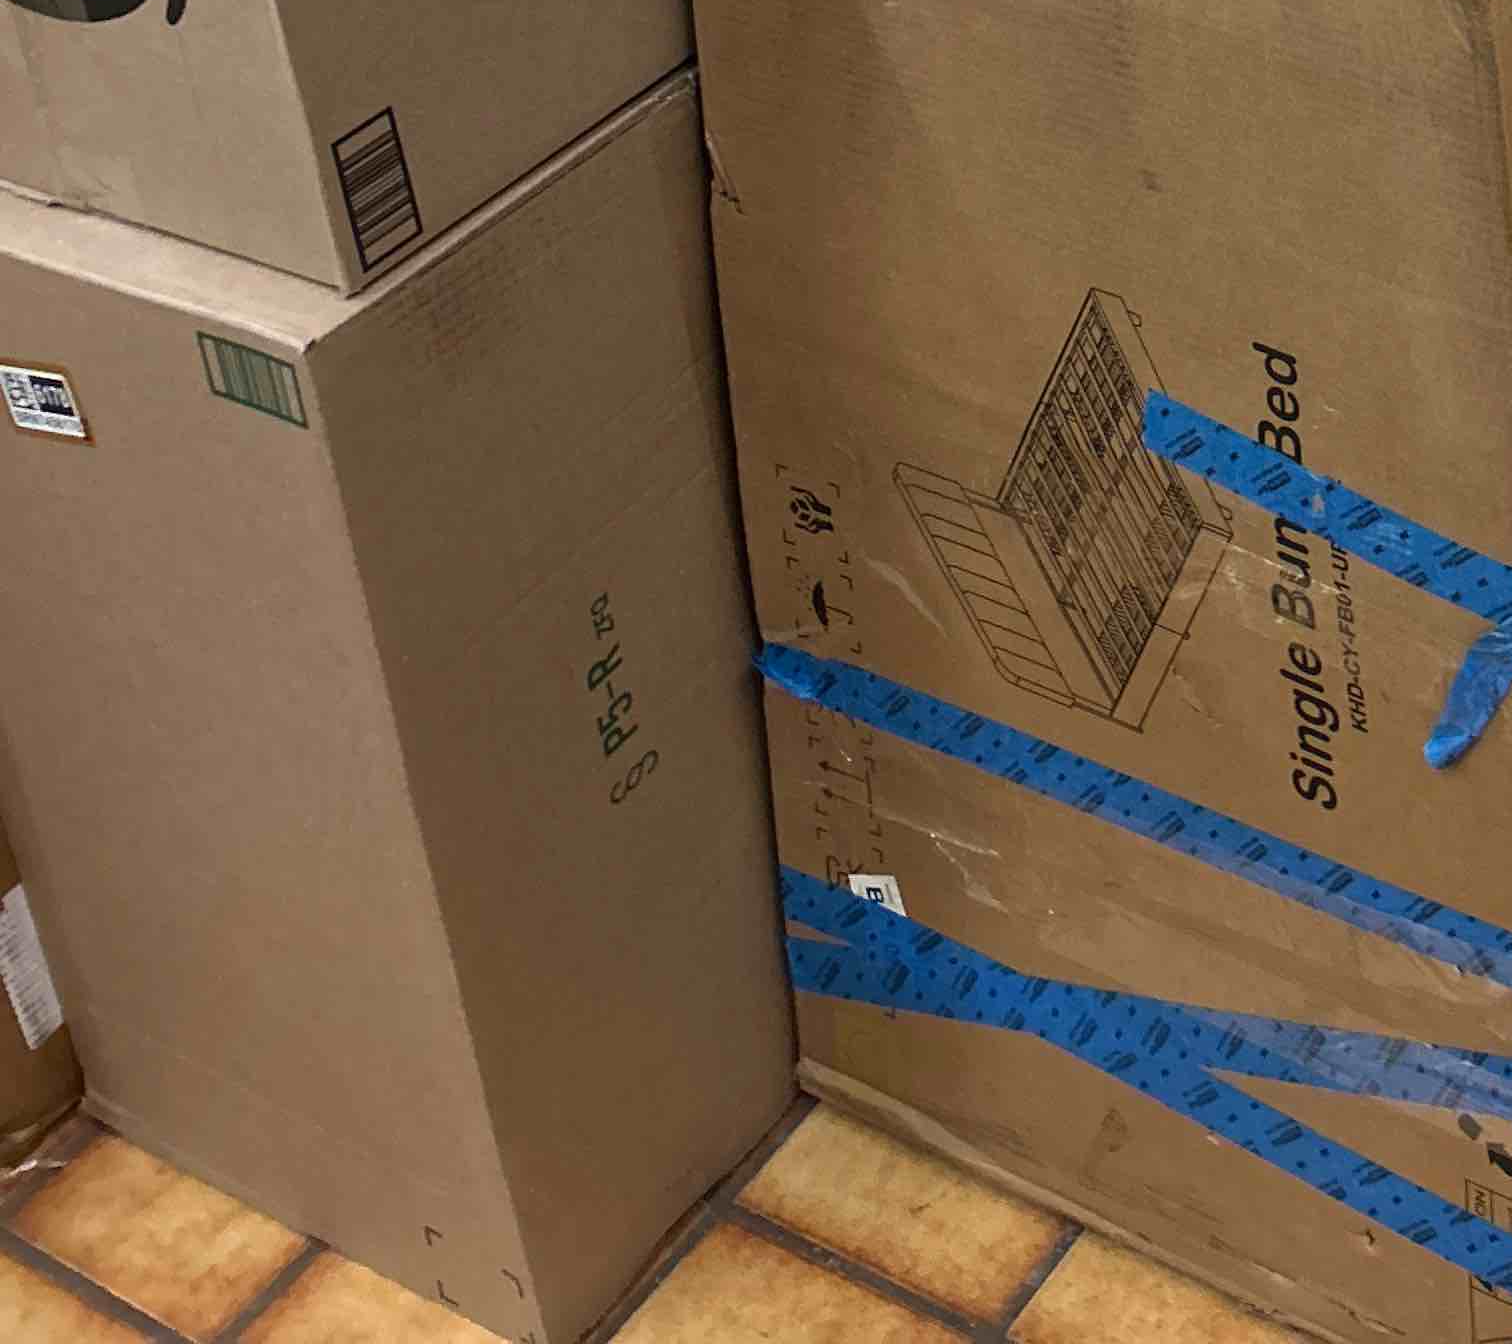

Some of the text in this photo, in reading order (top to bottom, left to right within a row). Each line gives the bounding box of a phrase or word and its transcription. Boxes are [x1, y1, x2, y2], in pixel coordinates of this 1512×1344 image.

[1252, 341, 1340, 812] Single Bun Bed
